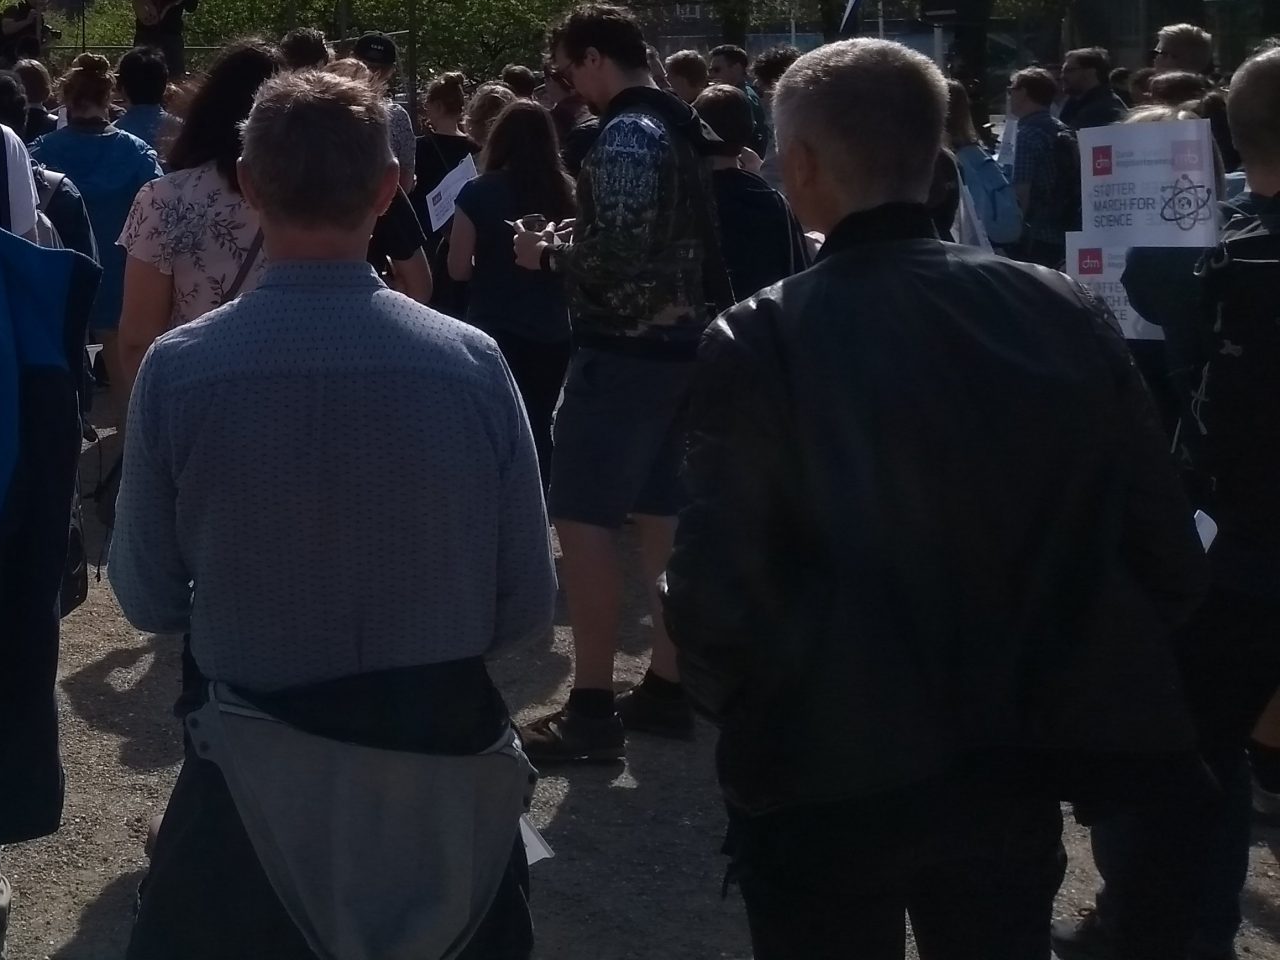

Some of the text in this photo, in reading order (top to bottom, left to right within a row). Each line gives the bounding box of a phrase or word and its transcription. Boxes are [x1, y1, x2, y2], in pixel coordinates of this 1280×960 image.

[1095, 154, 1110, 168] dm
[1093, 182, 1136, 197] STØTTER
[1094, 197, 1155, 211] MARCH FOR
[1094, 213, 1133, 228] SCIENCE
[1082, 255, 1100, 269] dm
